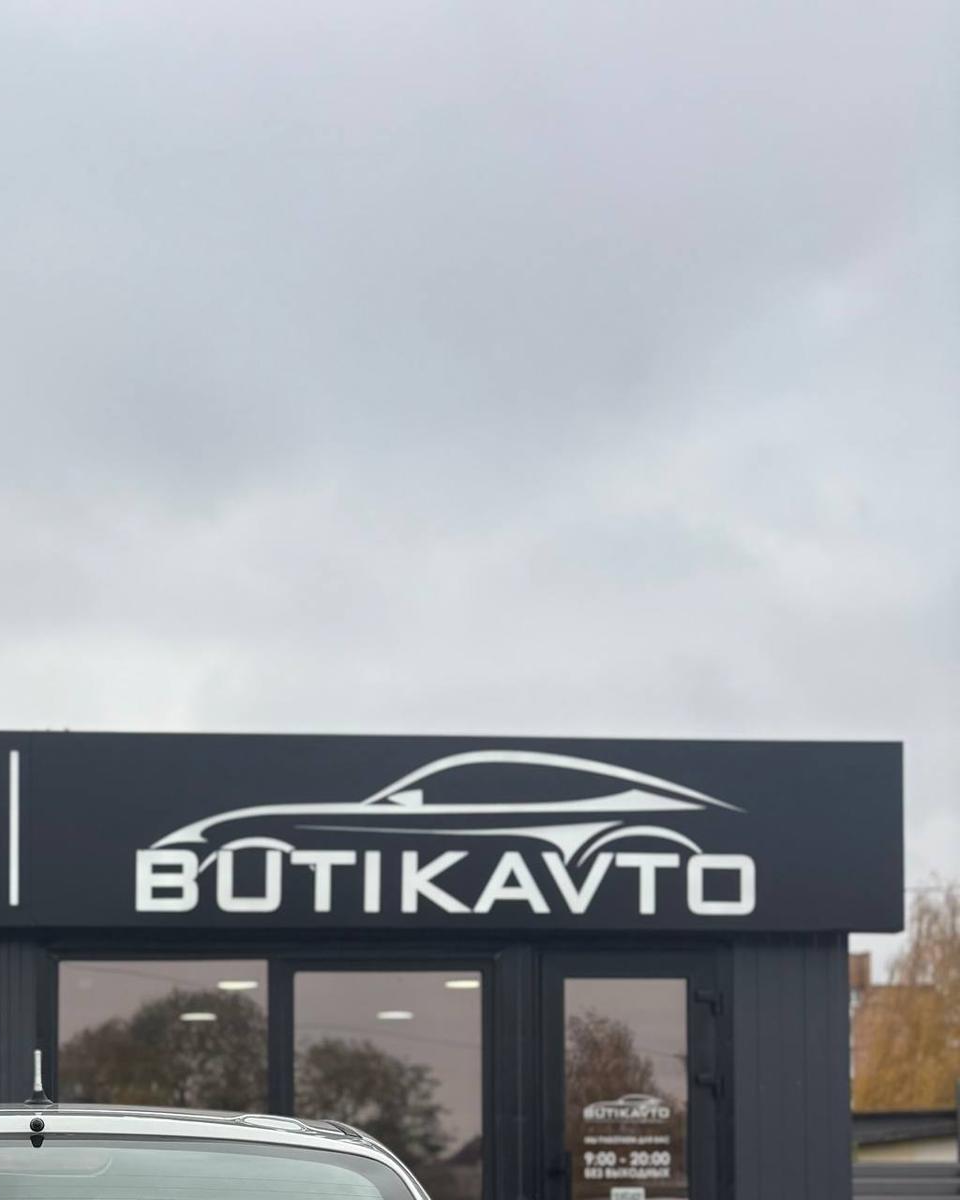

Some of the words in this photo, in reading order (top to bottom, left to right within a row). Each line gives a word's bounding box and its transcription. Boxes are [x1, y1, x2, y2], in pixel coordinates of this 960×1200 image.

[135, 849, 756, 915] BUTIKAVTO
[584, 1151, 616, 1166] 9:00
[630, 1151, 671, 1166] 20:00
